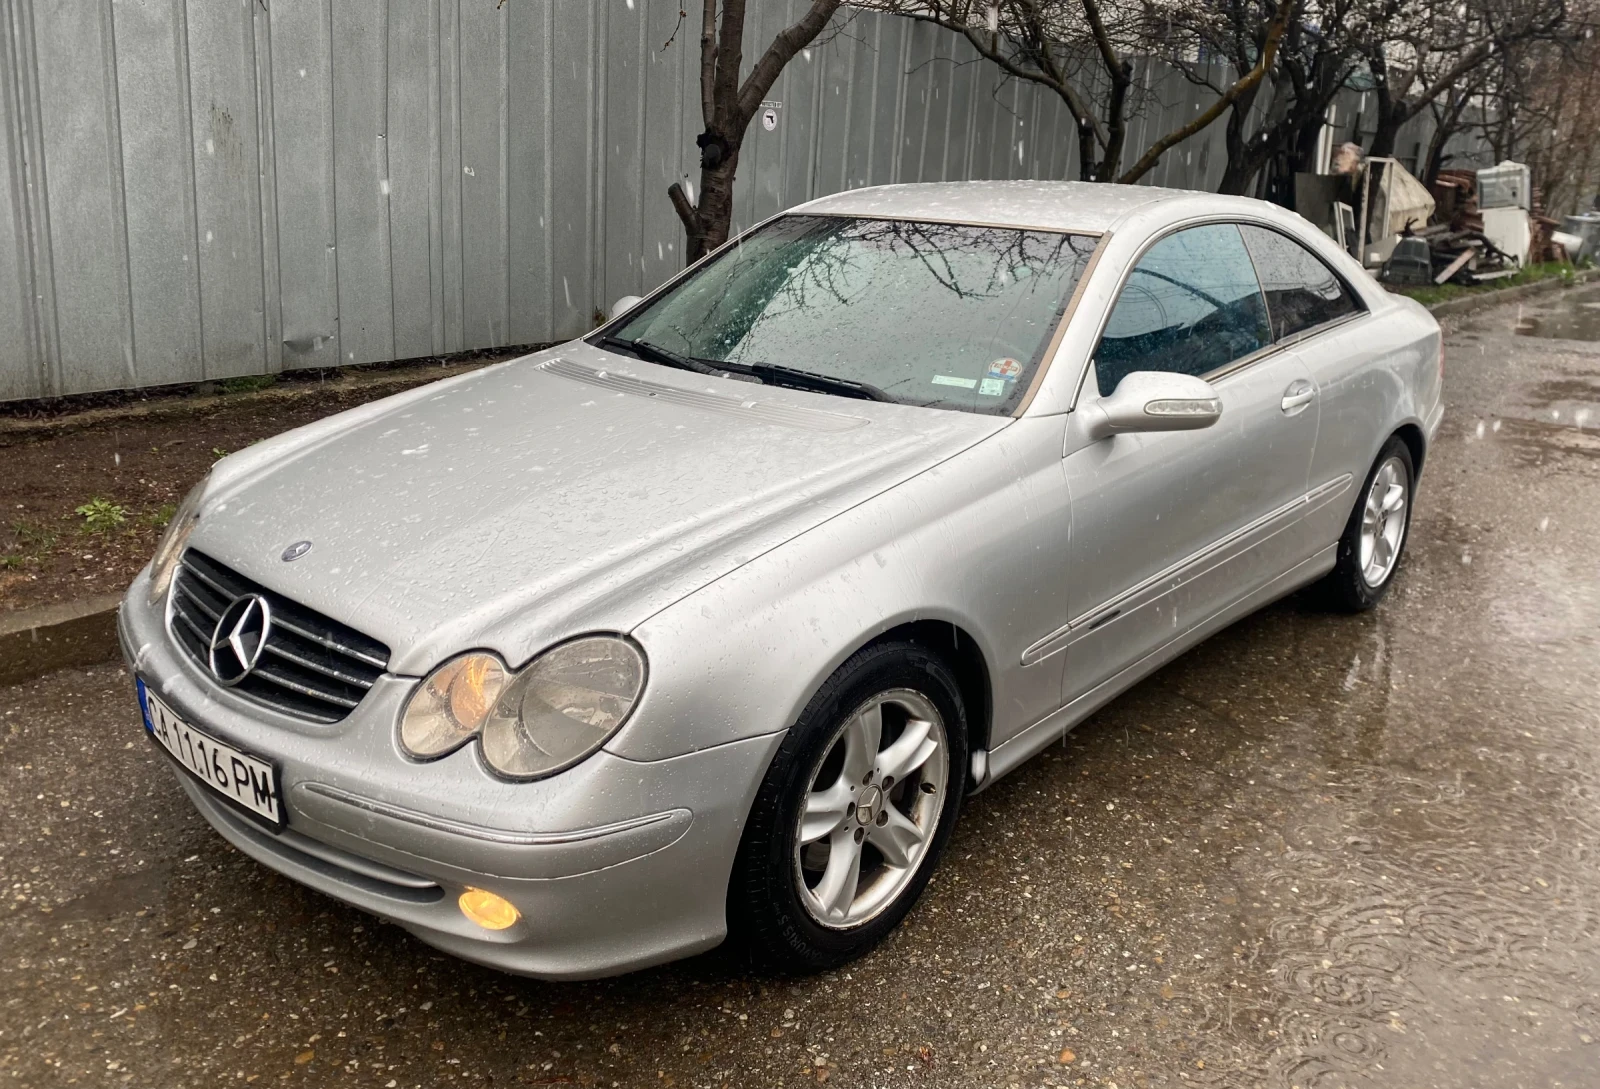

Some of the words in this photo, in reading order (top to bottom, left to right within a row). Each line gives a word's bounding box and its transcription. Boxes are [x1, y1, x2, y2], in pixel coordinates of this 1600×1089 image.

[148, 696, 173, 749] CA
[173, 721, 229, 788] 1116
[230, 755, 273, 813] PM
